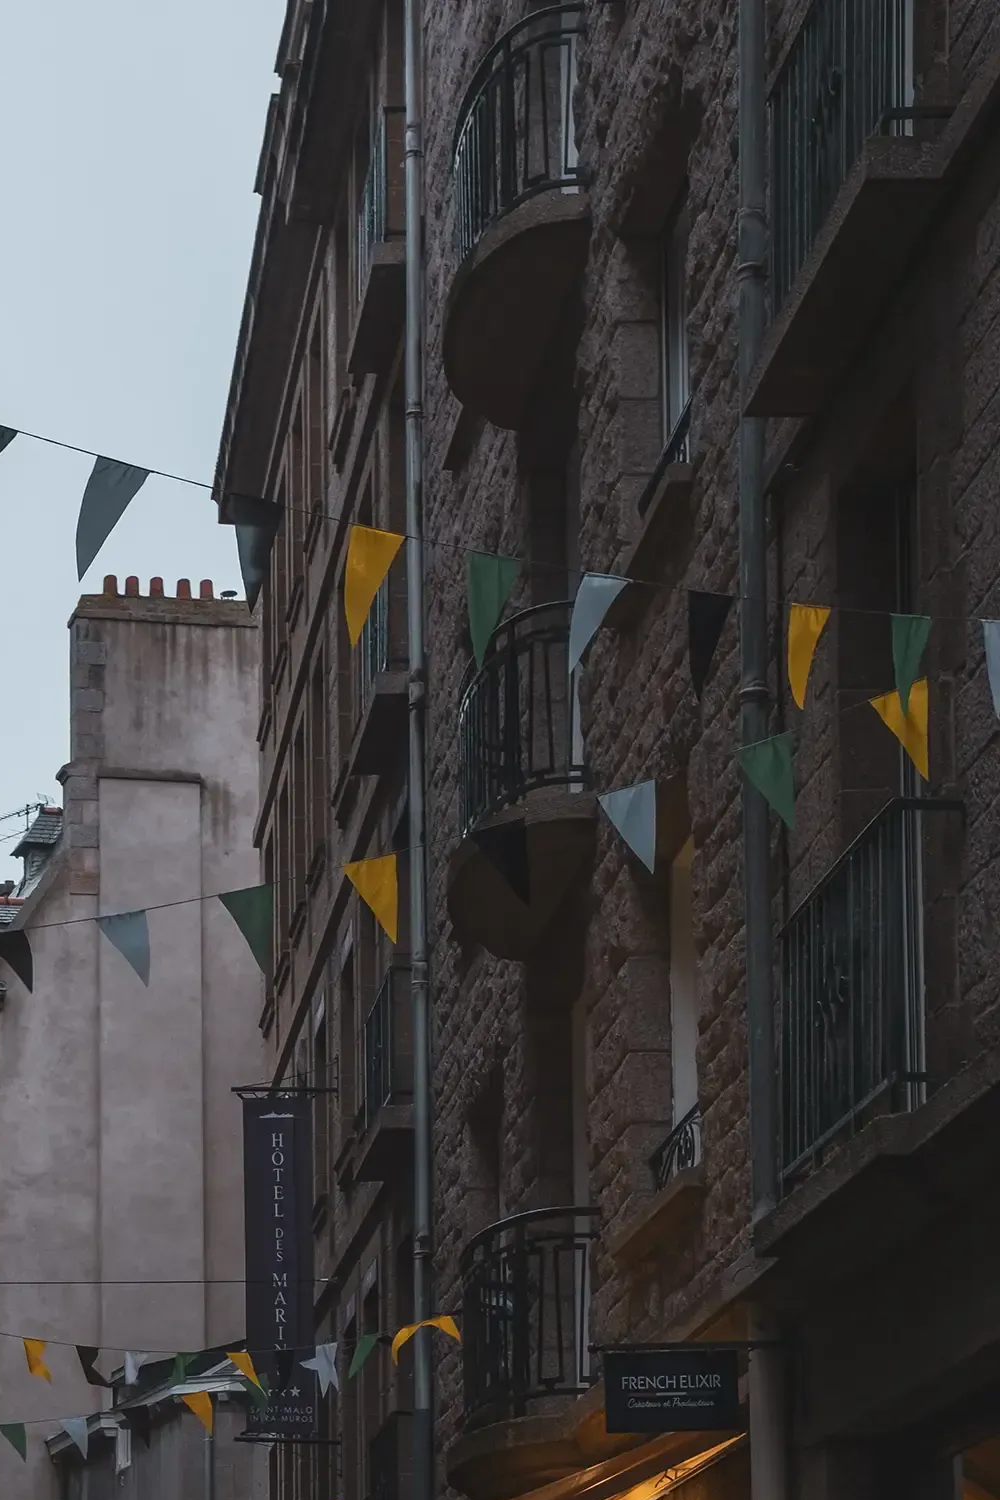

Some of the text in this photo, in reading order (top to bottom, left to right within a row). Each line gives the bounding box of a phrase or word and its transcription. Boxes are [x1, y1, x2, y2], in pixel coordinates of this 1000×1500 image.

[271, 1132, 285, 1218] HÔTEL
[275, 1227, 284, 1262] DES
[621, 1374, 722, 1390] FRENCH ELIXIR
[249, 1405, 314, 1415] SNT-MALO
[249, 1415, 314, 1424] INRA-MUROS
